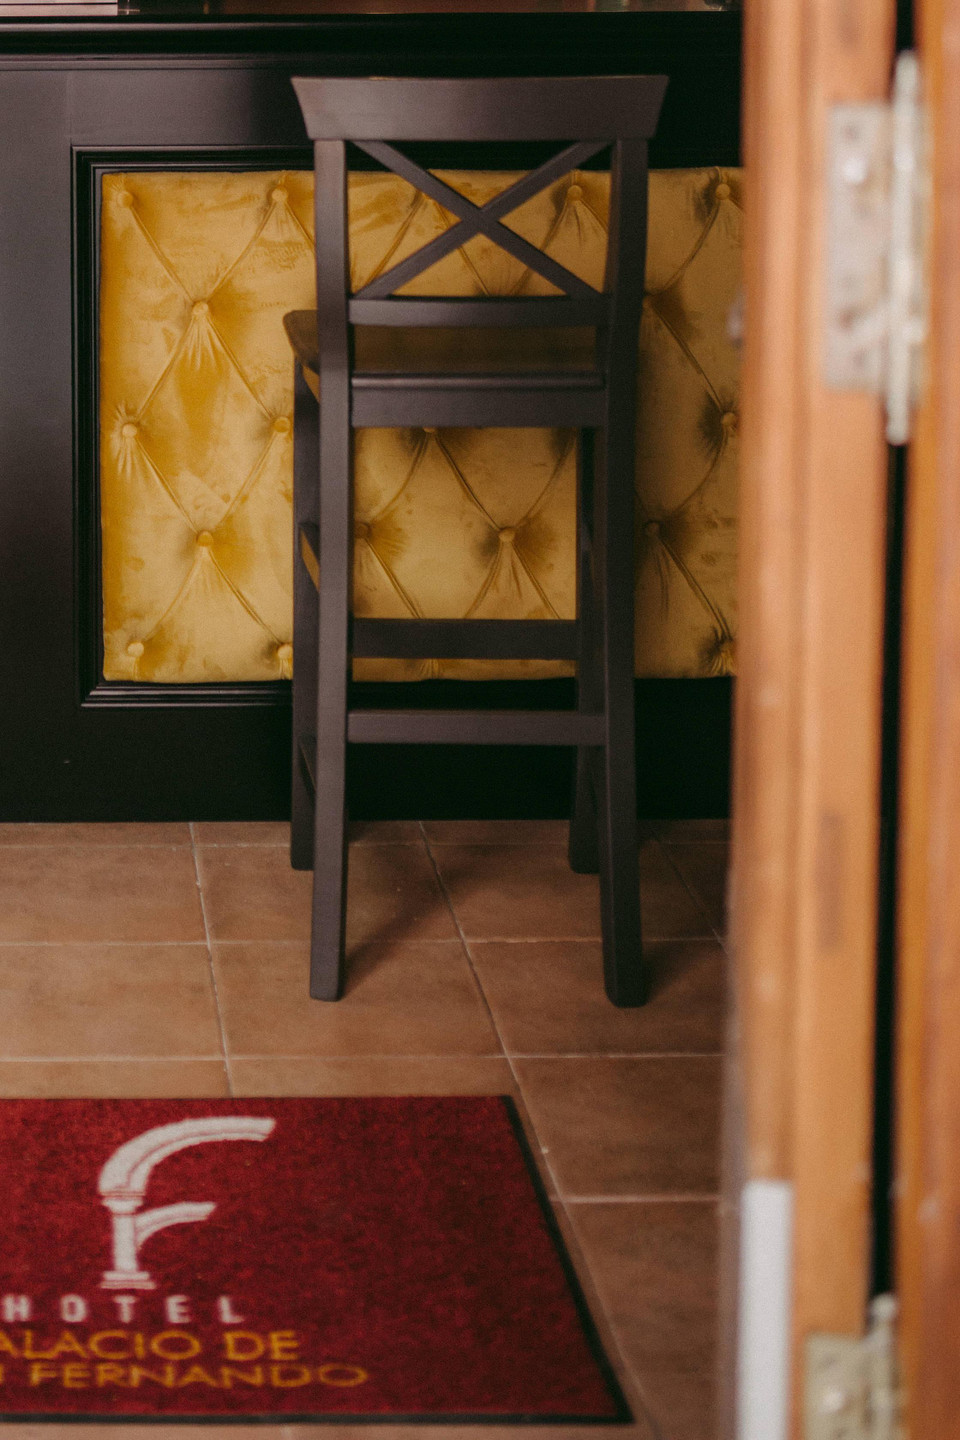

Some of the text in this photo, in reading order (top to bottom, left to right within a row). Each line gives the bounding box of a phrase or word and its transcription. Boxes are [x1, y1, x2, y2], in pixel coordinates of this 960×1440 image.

[1, 1294, 246, 1323] HOTEL
[222, 1330, 300, 1361] DE
[28, 1361, 370, 1389] FERNANDO
